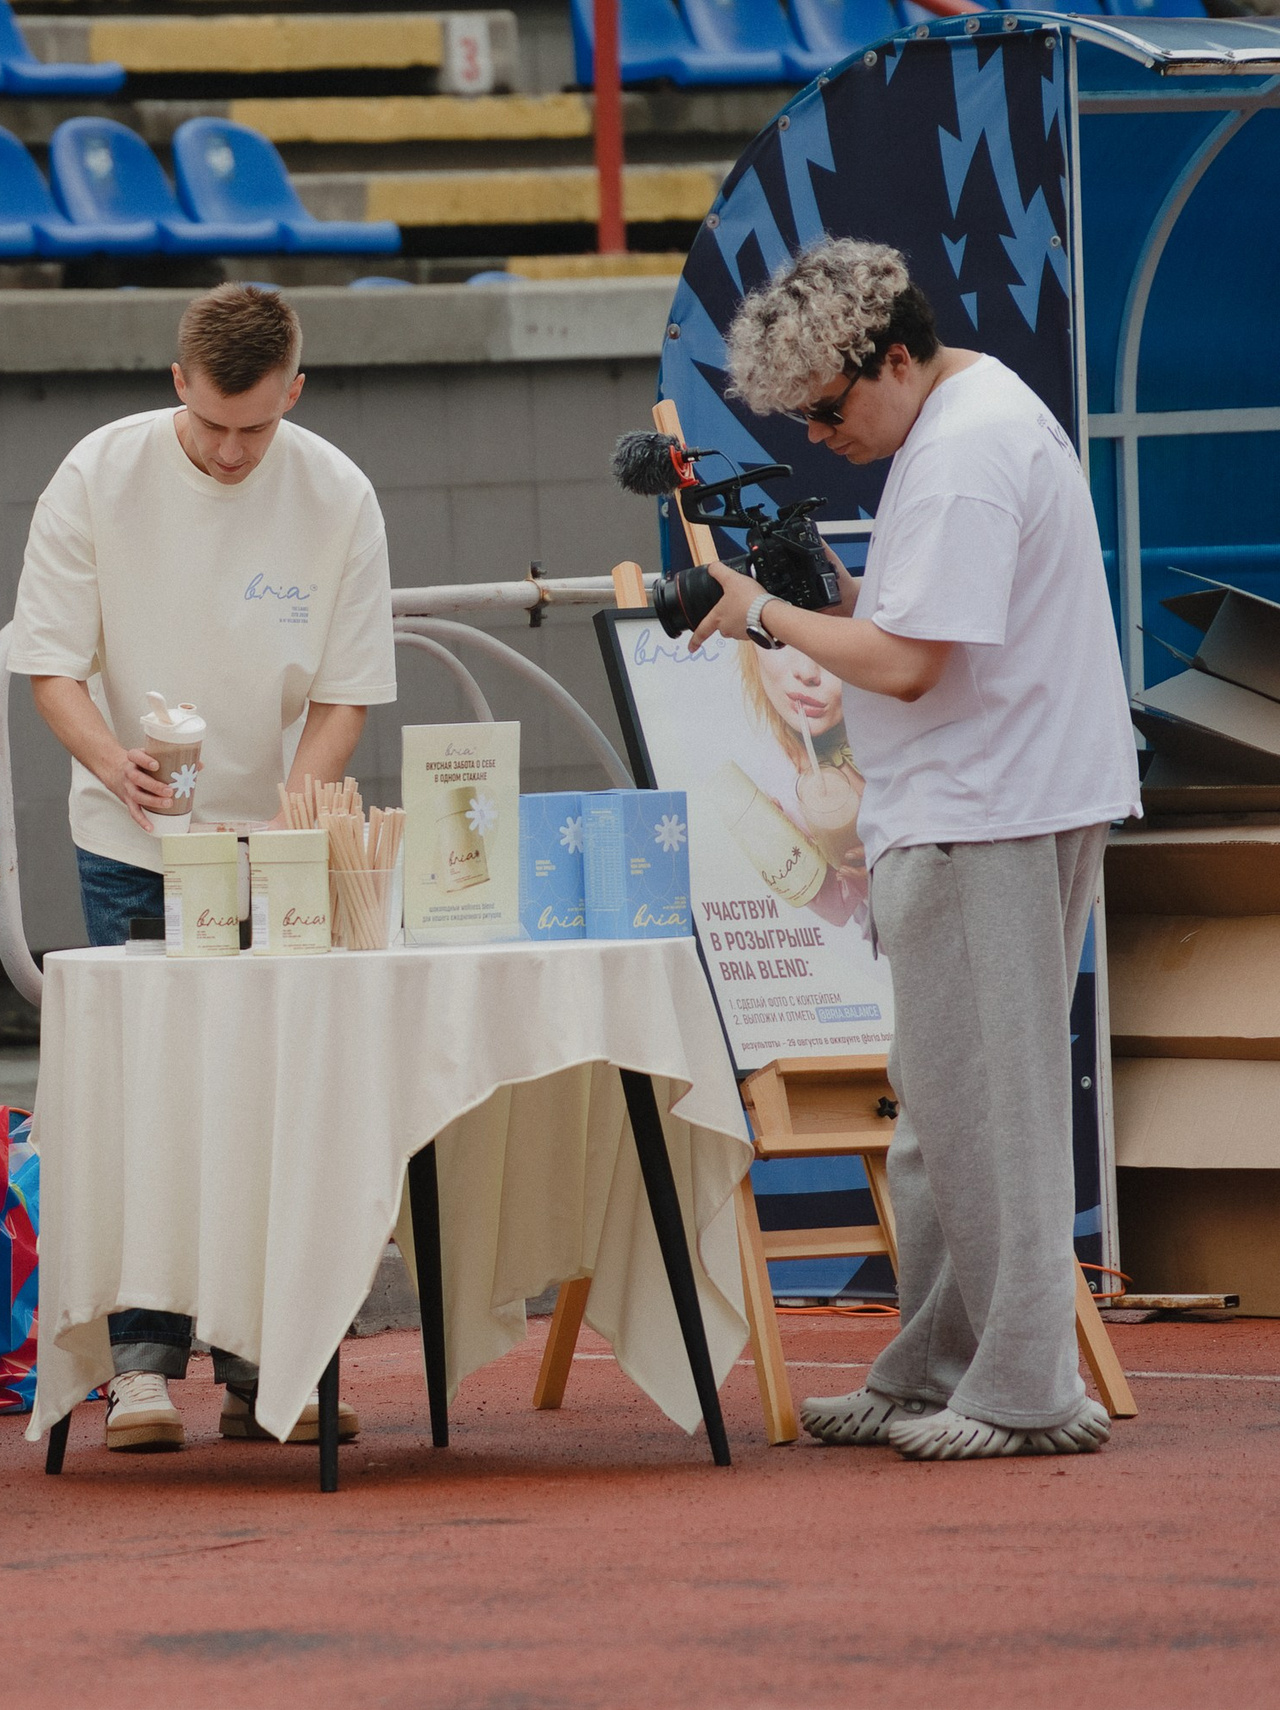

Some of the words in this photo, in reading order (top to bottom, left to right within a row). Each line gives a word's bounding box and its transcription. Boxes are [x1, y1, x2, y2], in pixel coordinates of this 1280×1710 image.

[244, 573, 311, 601] bria
[426, 760, 452, 771] ВКУСНАЯ
[453, 759, 475, 770] ЗАБОТА
[476, 759, 481, 769] О
[482, 759, 496, 769] СЕБЕ
[434, 775, 439, 783] В
[439, 773, 462, 784] ОДНОМ
[462, 772, 487, 782] СТАКАНЕ
[282, 908, 323, 926] bria
[633, 904, 687, 928] bria
[702, 895, 779, 921] УЧАСТВУЙ
[710, 932, 723, 951] В
[724, 927, 825, 951] РОЗЫГРЫШЕ
[719, 961, 756, 981] BRIA
[757, 958, 813, 979] BLEND:
[736, 995, 767, 1010] СДЕЛАЙ
[767, 995, 788, 1007] ФОТО
[789, 995, 795, 1006] С
[797, 992, 842, 1006] КОКТЕЙЛЕМ
[743, 1011, 778, 1025] ВЫЛОЖИ
[779, 1011, 785, 1022] И
[786, 1008, 815, 1022] ОТМЕТЬ
[819, 1004, 879, 1021] @BRIA.BALANCE
